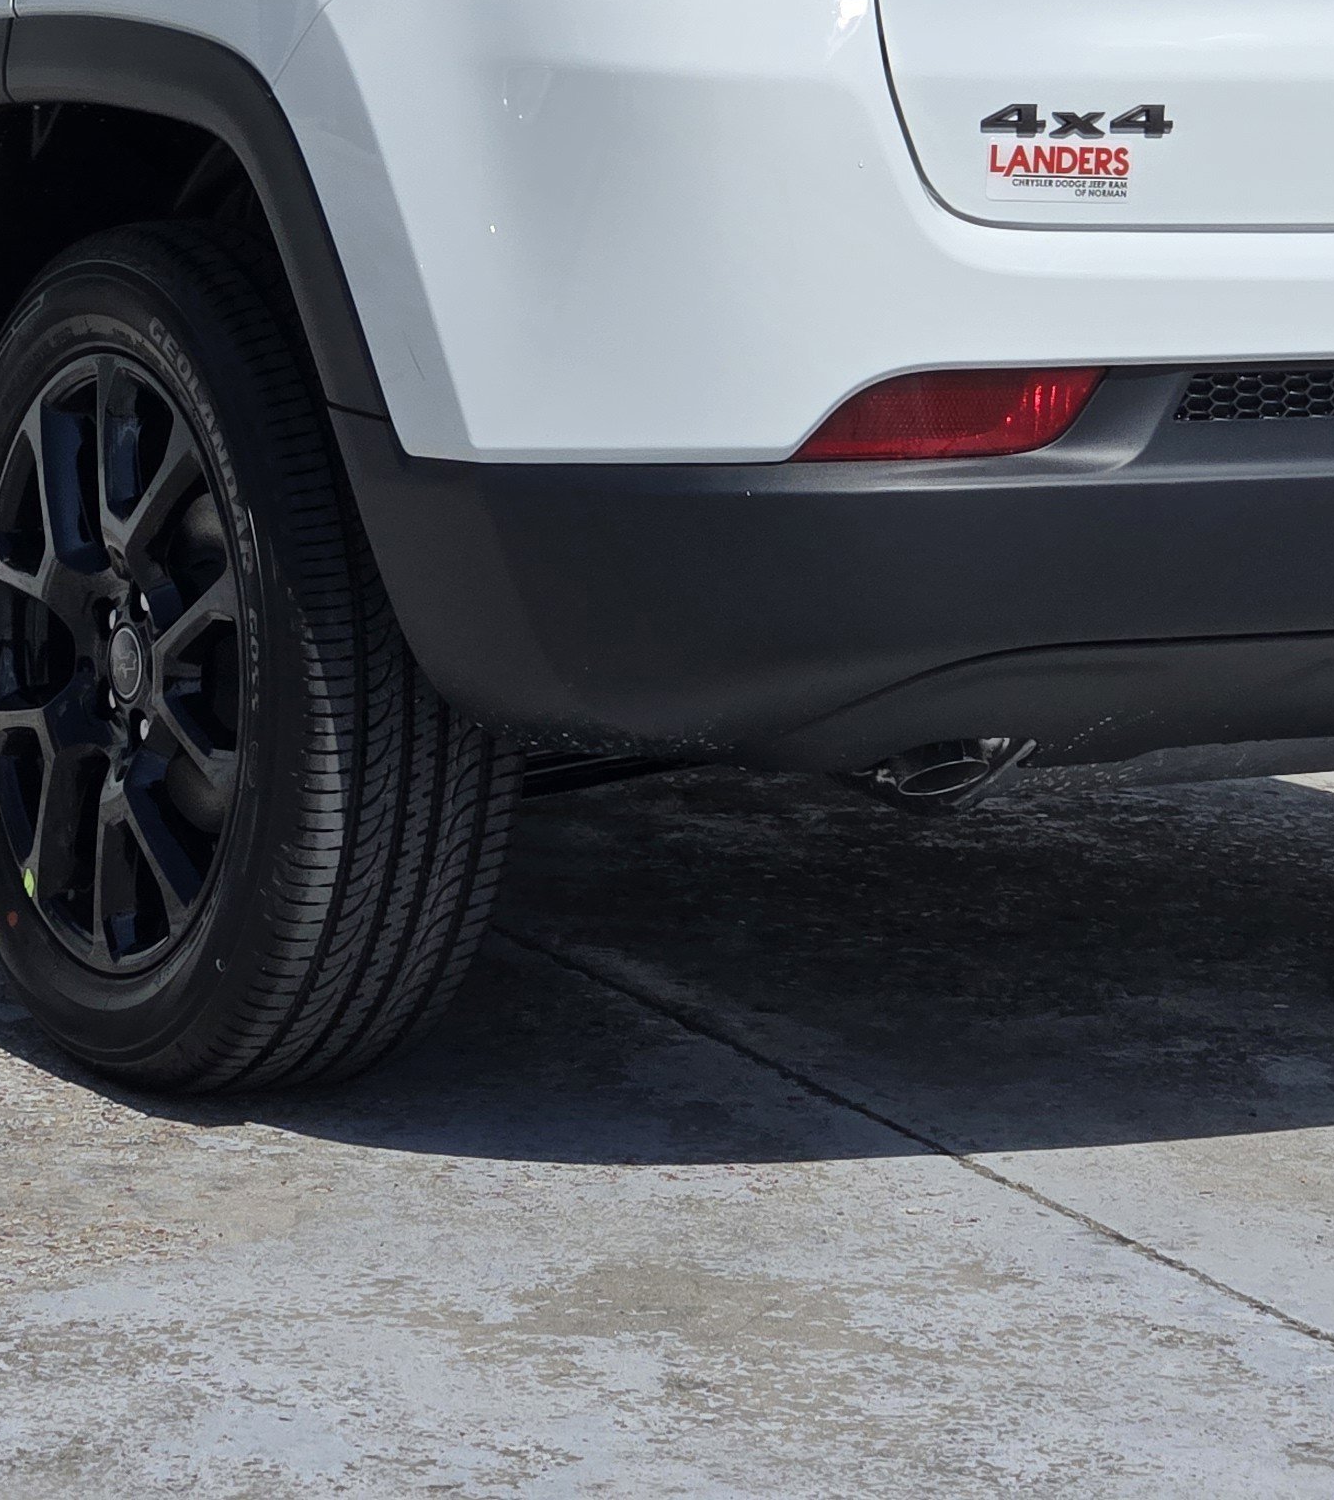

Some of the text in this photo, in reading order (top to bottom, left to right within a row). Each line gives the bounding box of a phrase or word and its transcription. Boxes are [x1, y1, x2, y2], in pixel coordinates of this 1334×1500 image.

[980, 103, 1173, 139] 4x4
[989, 144, 1130, 177] LANDERS
[1012, 178, 1128, 189] CHRYSLER DODGE JEEP RAM
[1074, 189, 1127, 198] OF NORMAN
